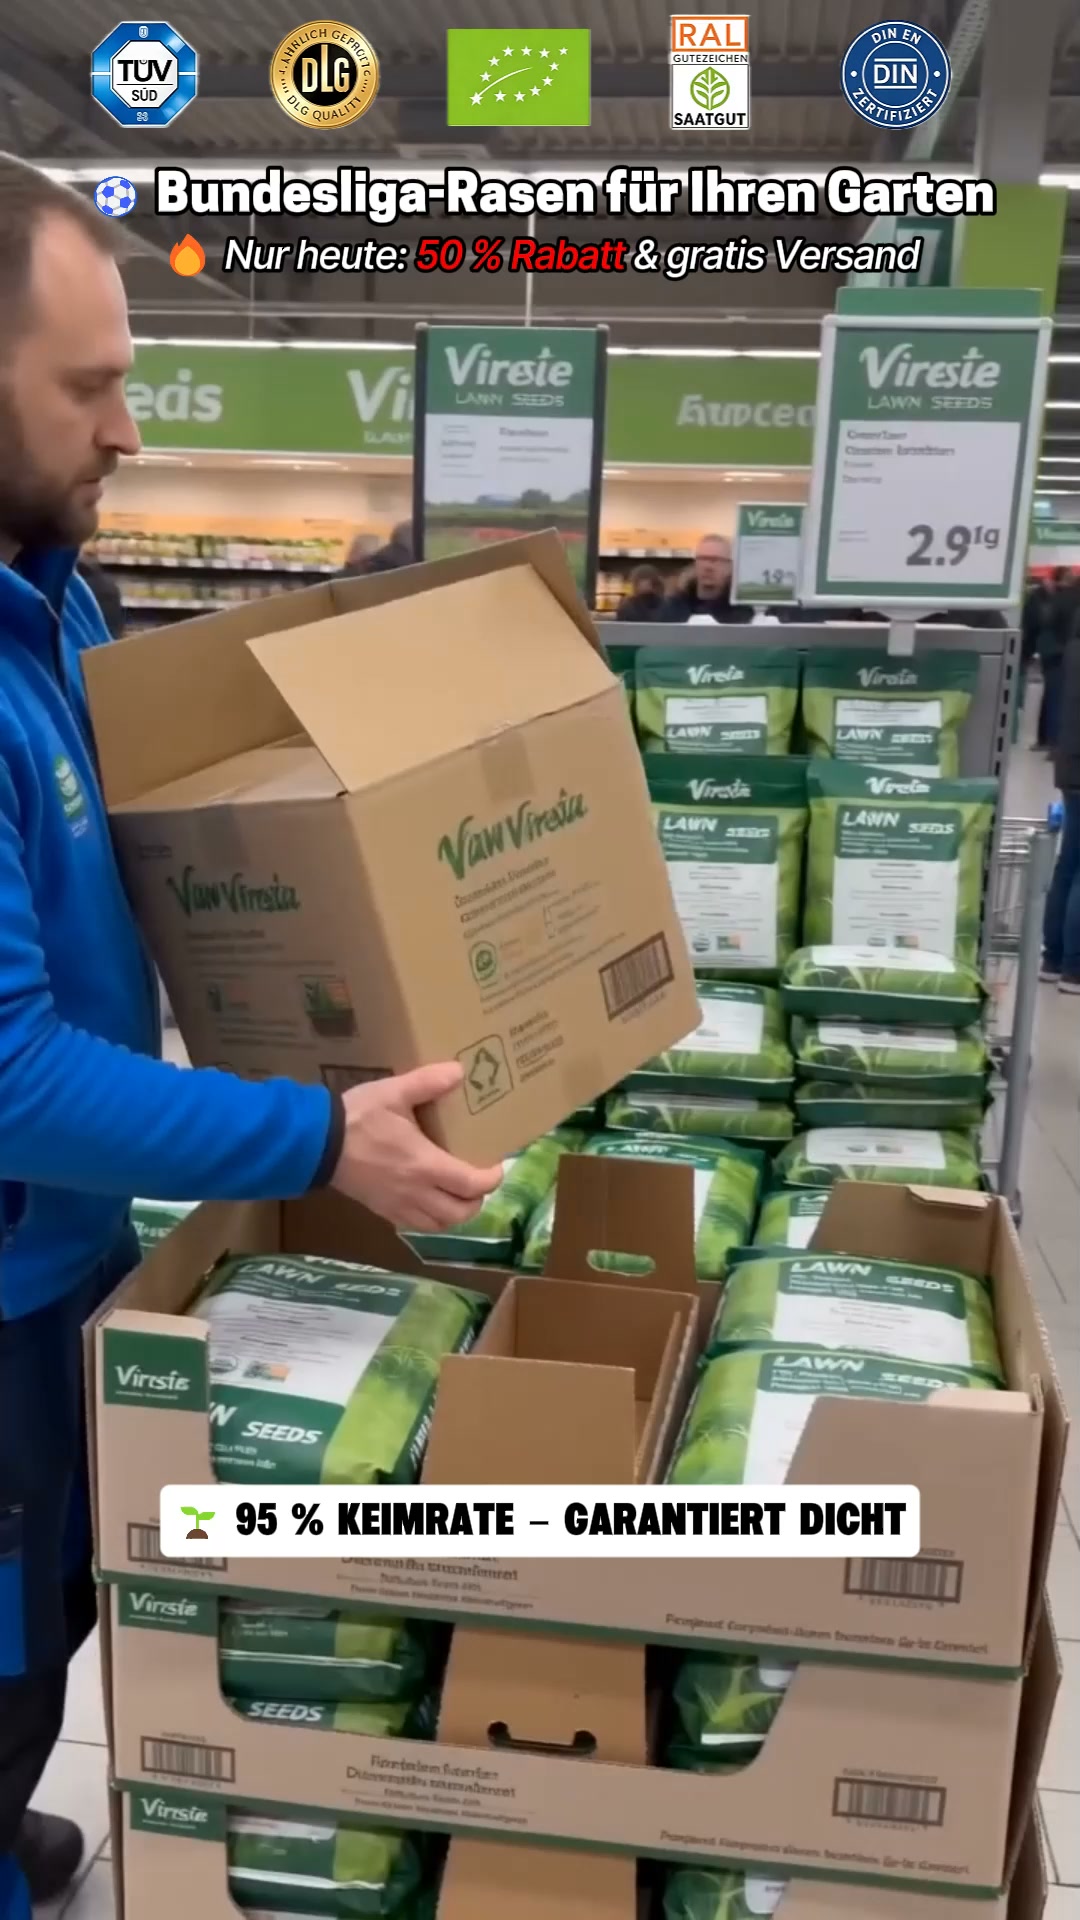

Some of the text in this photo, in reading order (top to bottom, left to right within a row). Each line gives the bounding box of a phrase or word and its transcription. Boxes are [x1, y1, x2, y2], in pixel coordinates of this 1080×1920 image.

[867, 395, 993, 410] LAWN SEEDS
[667, 726, 714, 739] LAWN
[836, 728, 885, 741] LAWN
[663, 816, 719, 832] LAWN
[841, 810, 901, 828] LAWN
[238, 1263, 327, 1284] LAWN
[790, 1261, 873, 1277] LAWN
[884, 1275, 955, 1293] SEEDS
[772, 1355, 866, 1373] LAWN
[241, 1421, 323, 1445] SEEDS
[247, 1701, 326, 1722] SEEDS
